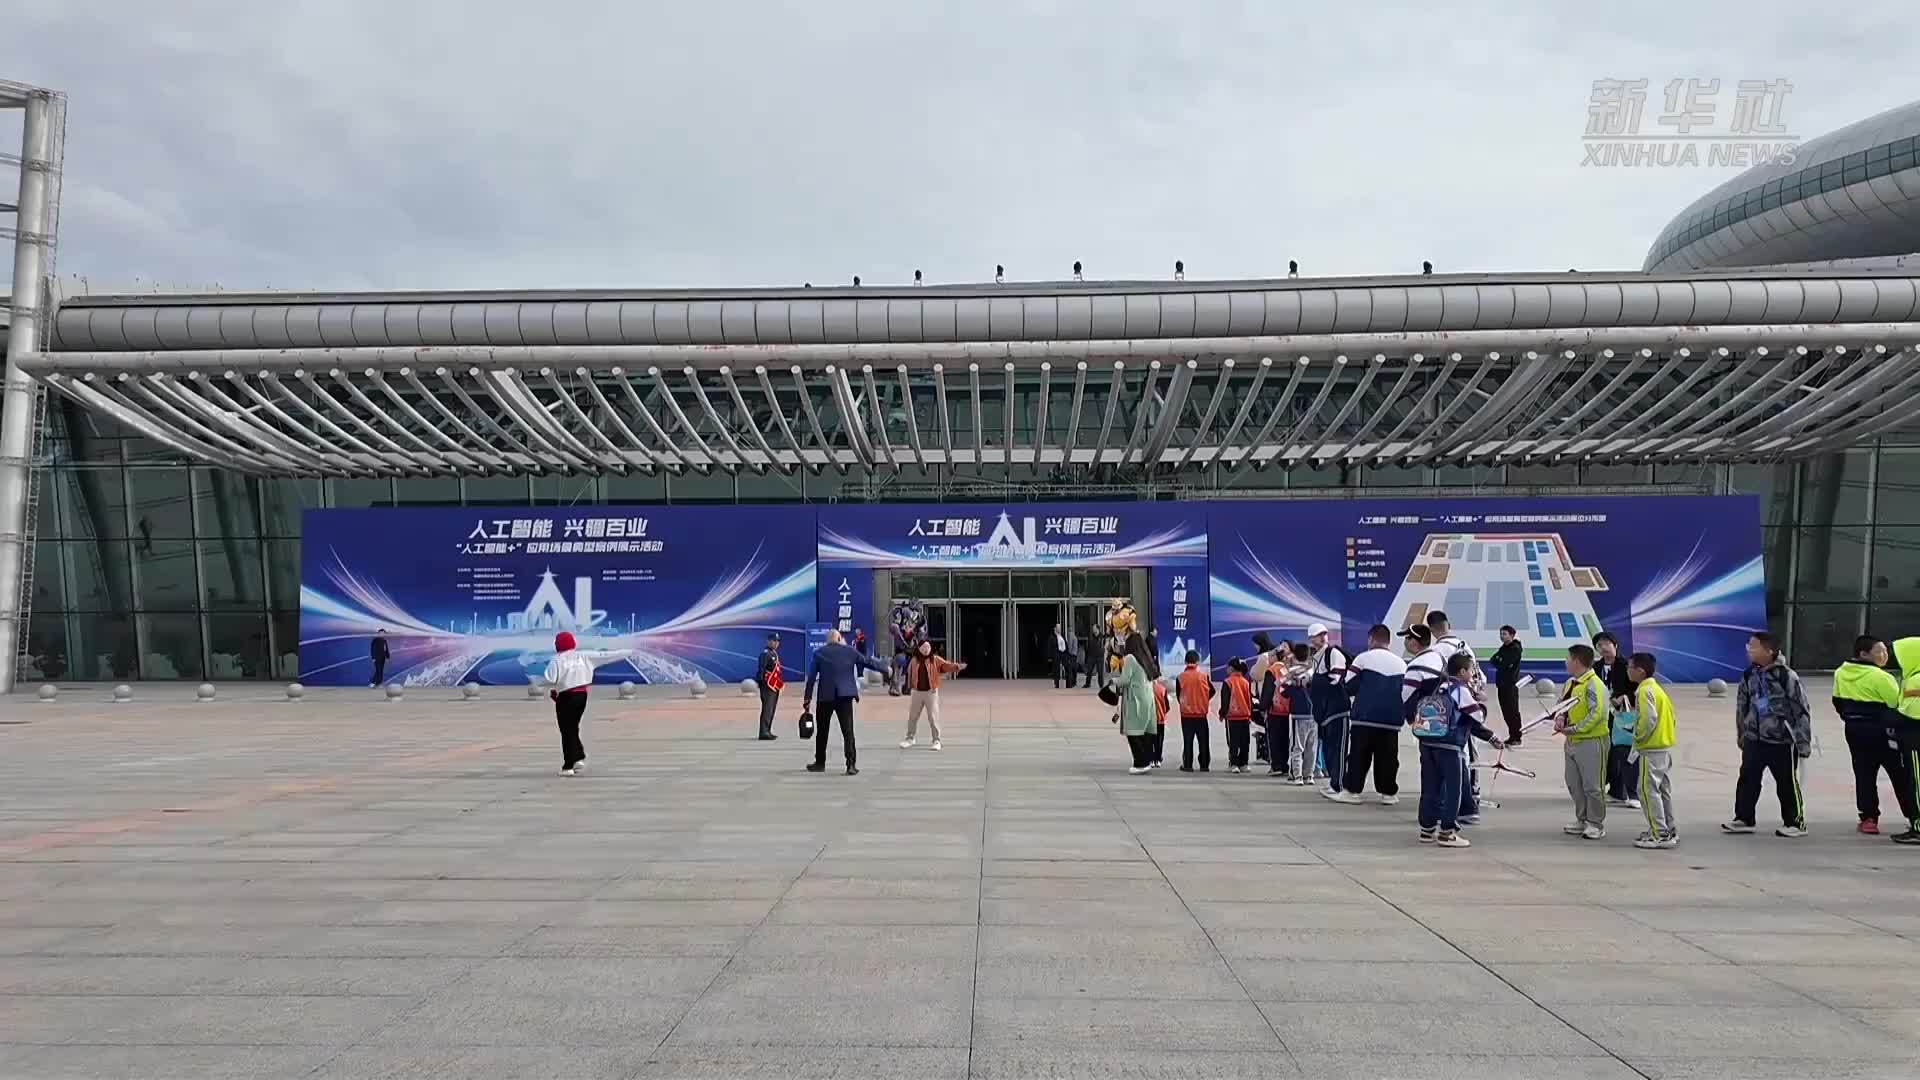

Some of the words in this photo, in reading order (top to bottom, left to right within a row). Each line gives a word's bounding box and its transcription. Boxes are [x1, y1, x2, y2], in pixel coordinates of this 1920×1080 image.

[469, 519, 553, 539] 人工智能
[908, 519, 981, 536] 人工智能
